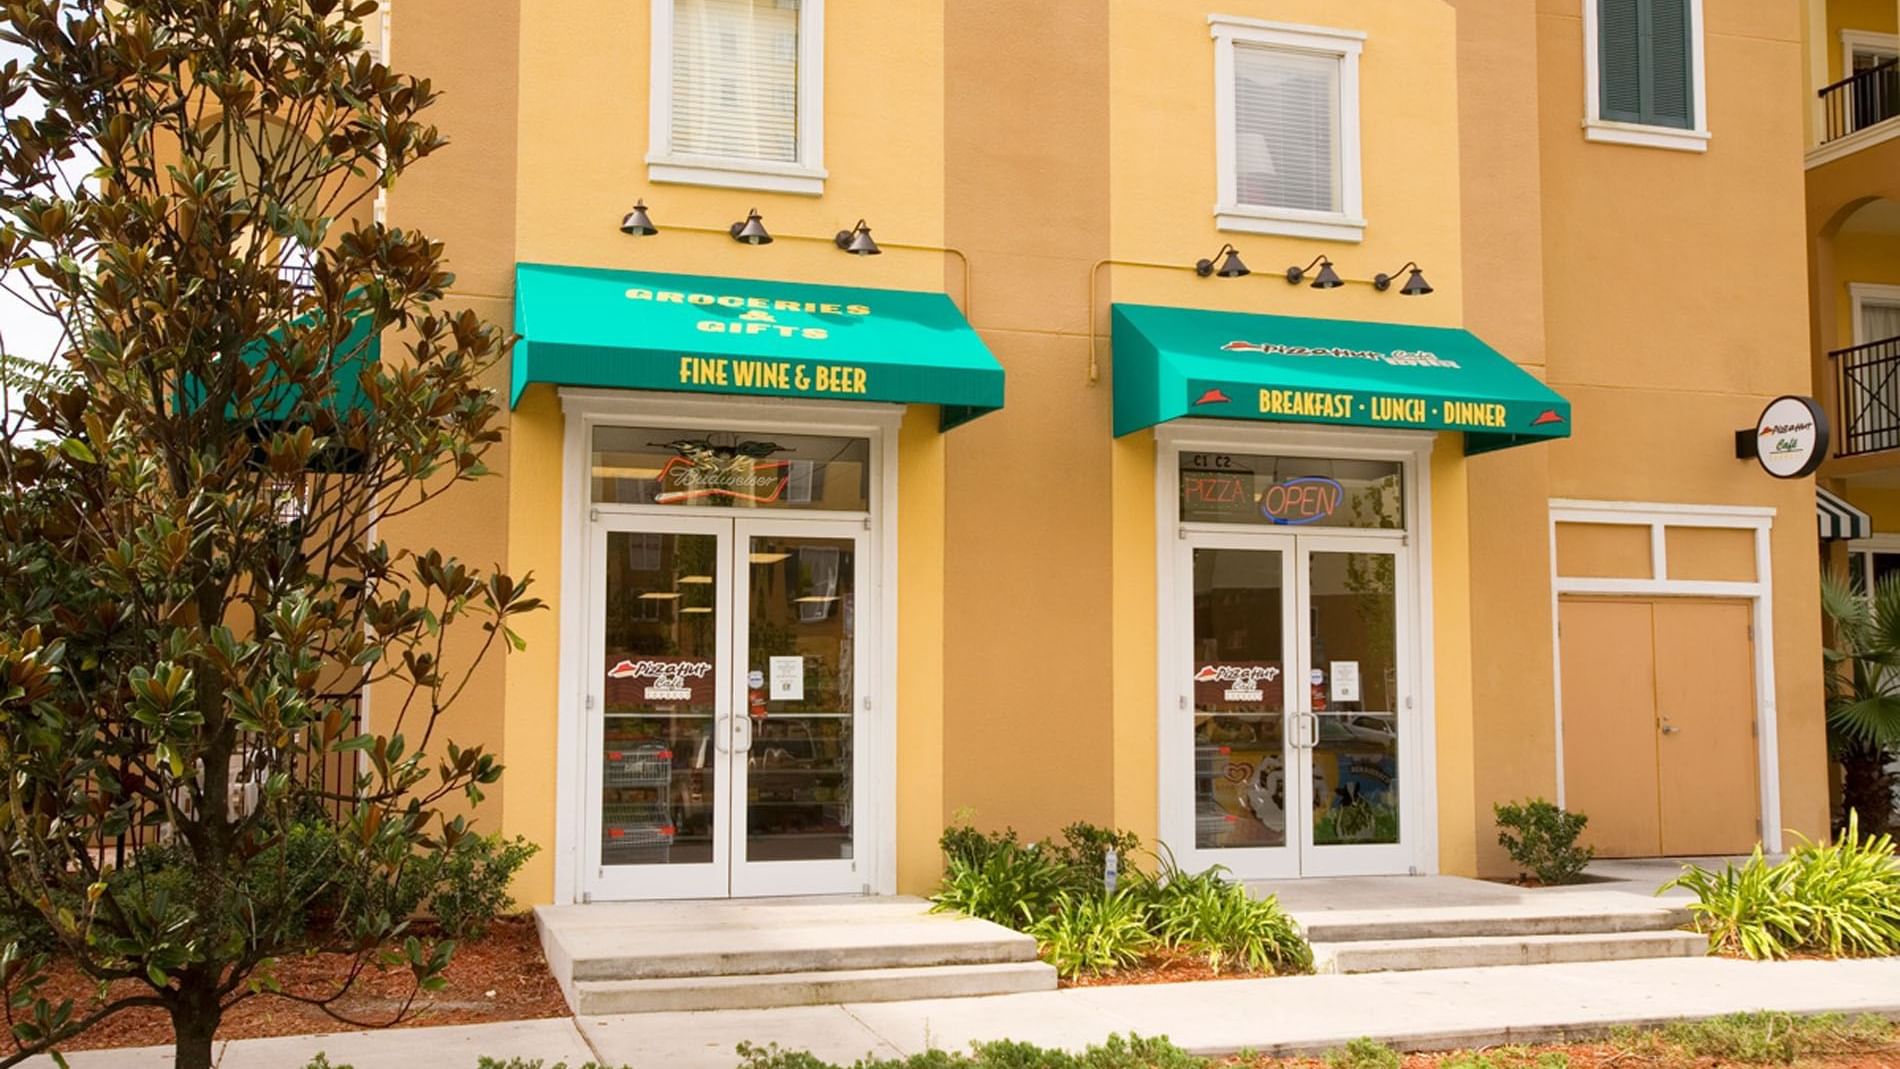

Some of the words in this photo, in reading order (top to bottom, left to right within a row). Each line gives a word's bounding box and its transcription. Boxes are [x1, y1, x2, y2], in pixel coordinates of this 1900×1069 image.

[625, 288, 871, 316] GROCERIES
[739, 310, 776, 323] &
[696, 320, 829, 340] GIFTS
[680, 357, 728, 386] FINE
[732, 360, 790, 389] WINE
[794, 364, 811, 391] &
[815, 365, 867, 393] BEER
[1259, 388, 1353, 418] BREAKFAST
[1371, 397, 1426, 422] LUNCH
[1444, 401, 1506, 427] DINNER
[1194, 455, 1208, 467] C1
[1215, 456, 1231, 468] C2
[669, 466, 778, 487] Budweiser
[1184, 478, 1246, 504] PIZZA
[1266, 485, 1337, 516] OPEN
